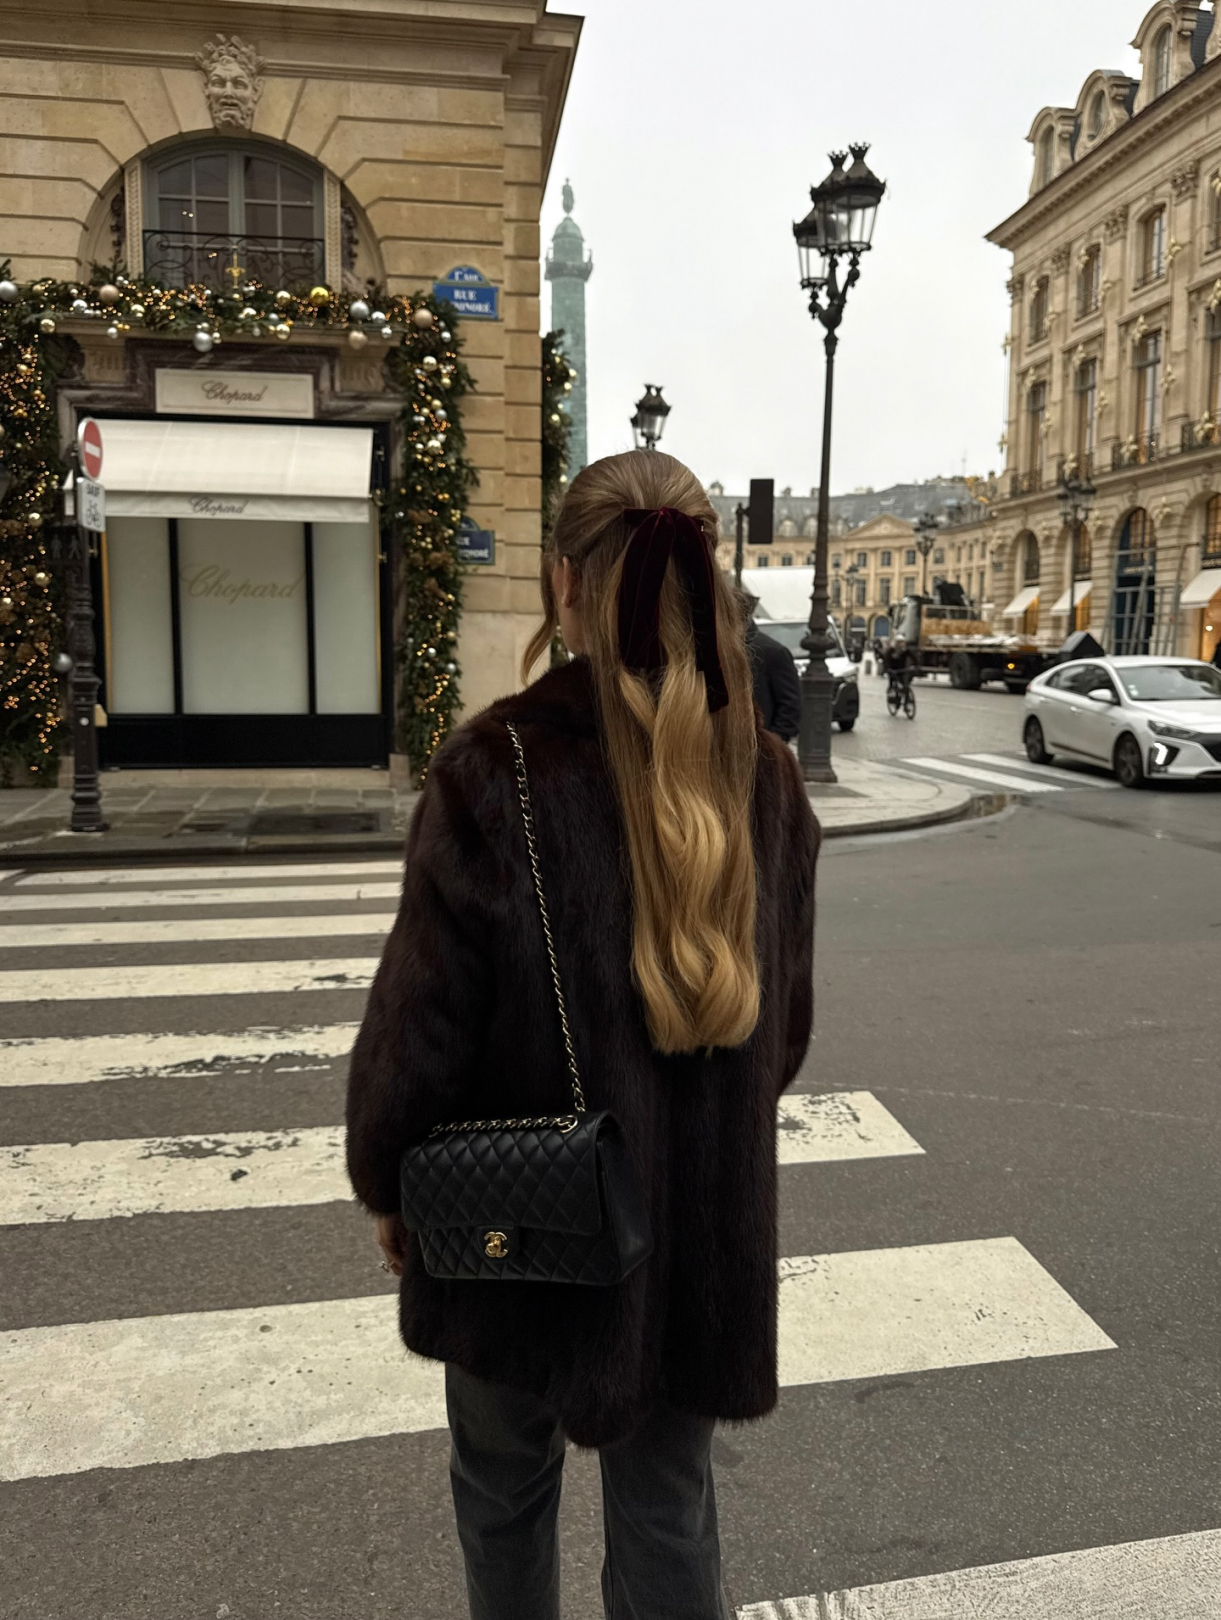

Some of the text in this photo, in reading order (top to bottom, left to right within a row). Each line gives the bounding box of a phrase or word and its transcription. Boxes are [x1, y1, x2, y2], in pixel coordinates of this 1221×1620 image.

[200, 380, 269, 405] Chopard
[188, 496, 249, 516] Chopard
[179, 563, 306, 606] Chopard
